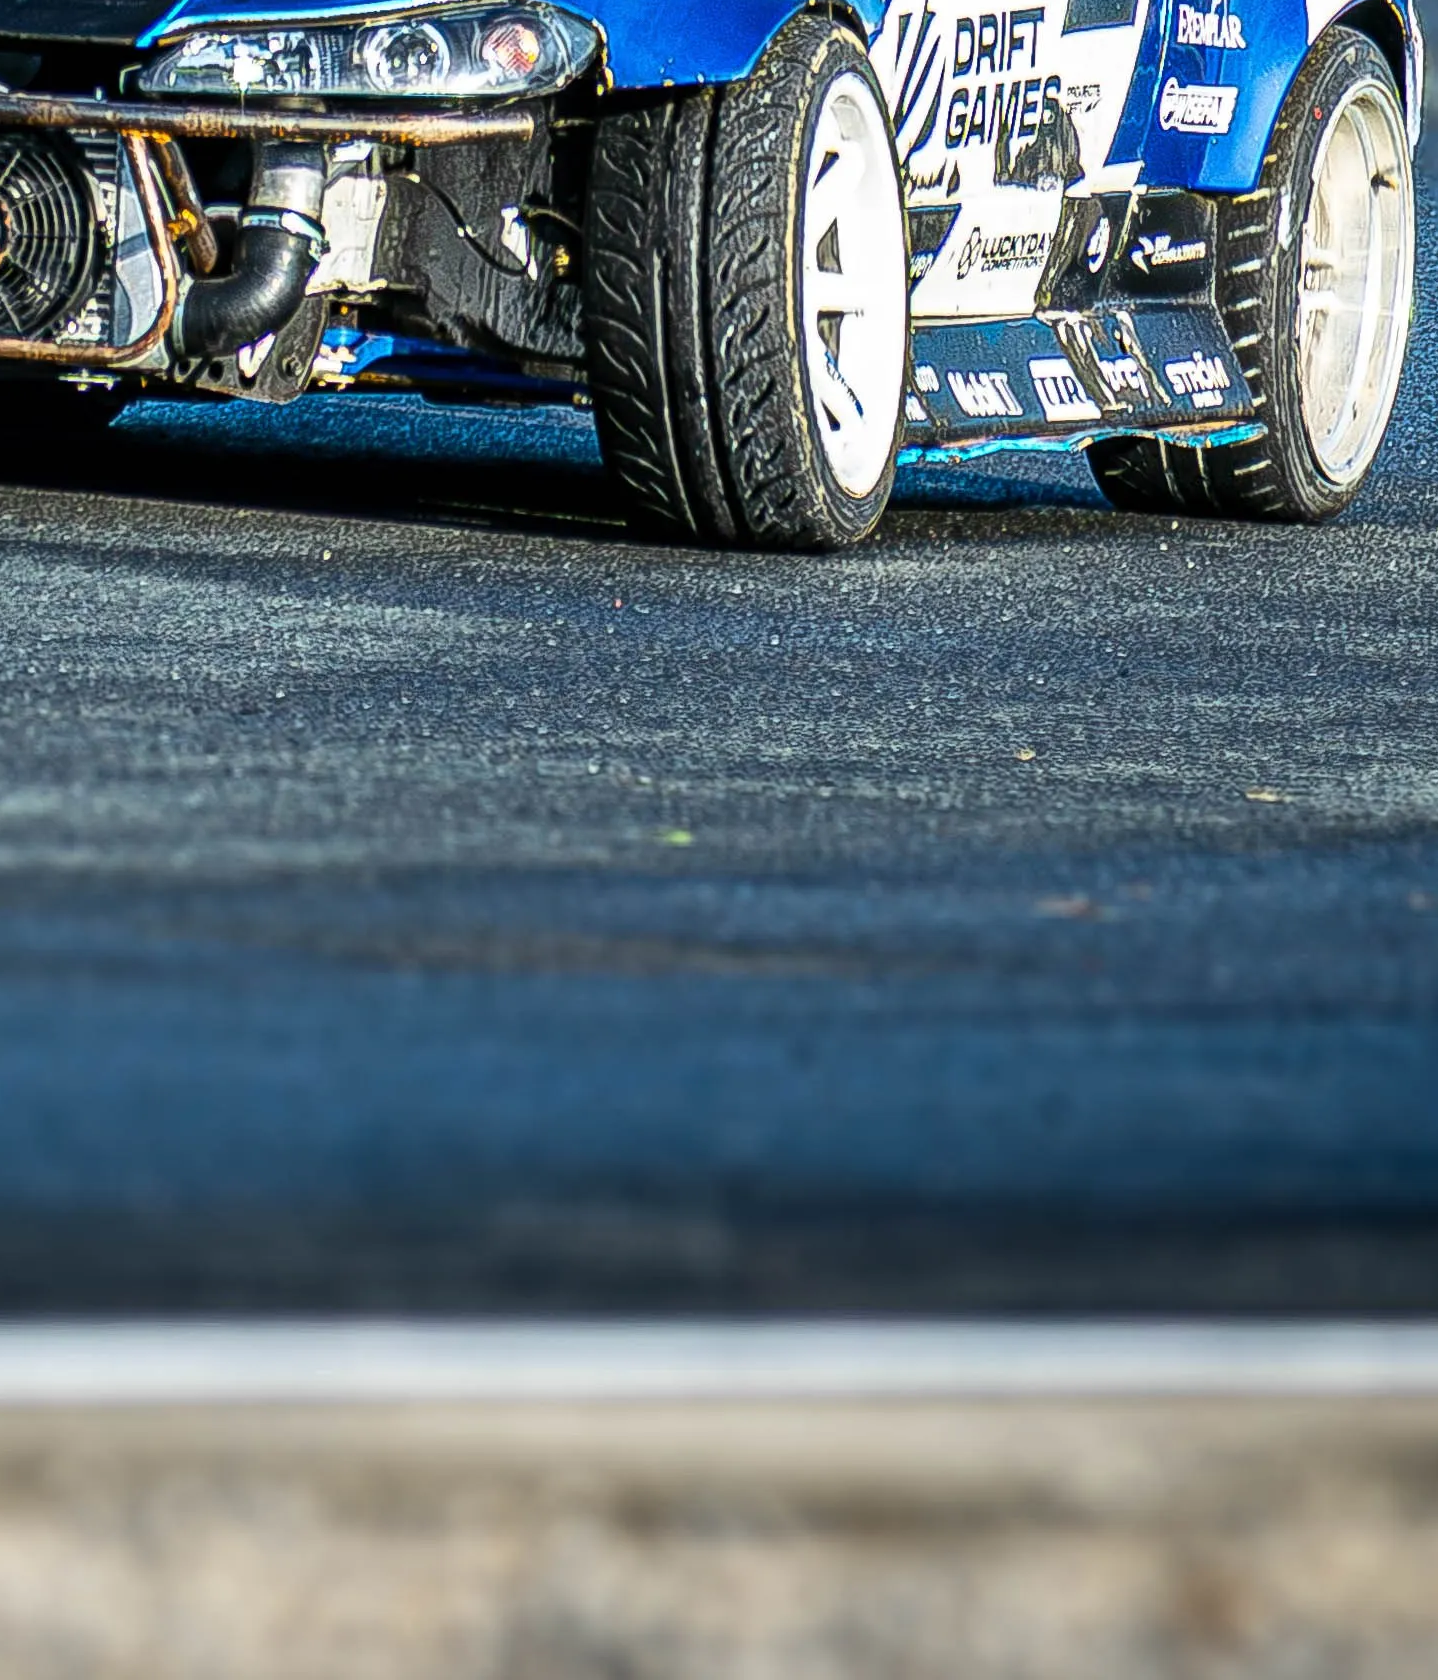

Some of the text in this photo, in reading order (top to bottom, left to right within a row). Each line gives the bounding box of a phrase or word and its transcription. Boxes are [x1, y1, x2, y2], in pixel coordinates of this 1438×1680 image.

[952, 6, 1045, 79] DRIFT
[944, 74, 1062, 151] GAMES
[981, 232, 1055, 258] LUCKYDAY
[1164, 350, 1231, 395] STRÖM
